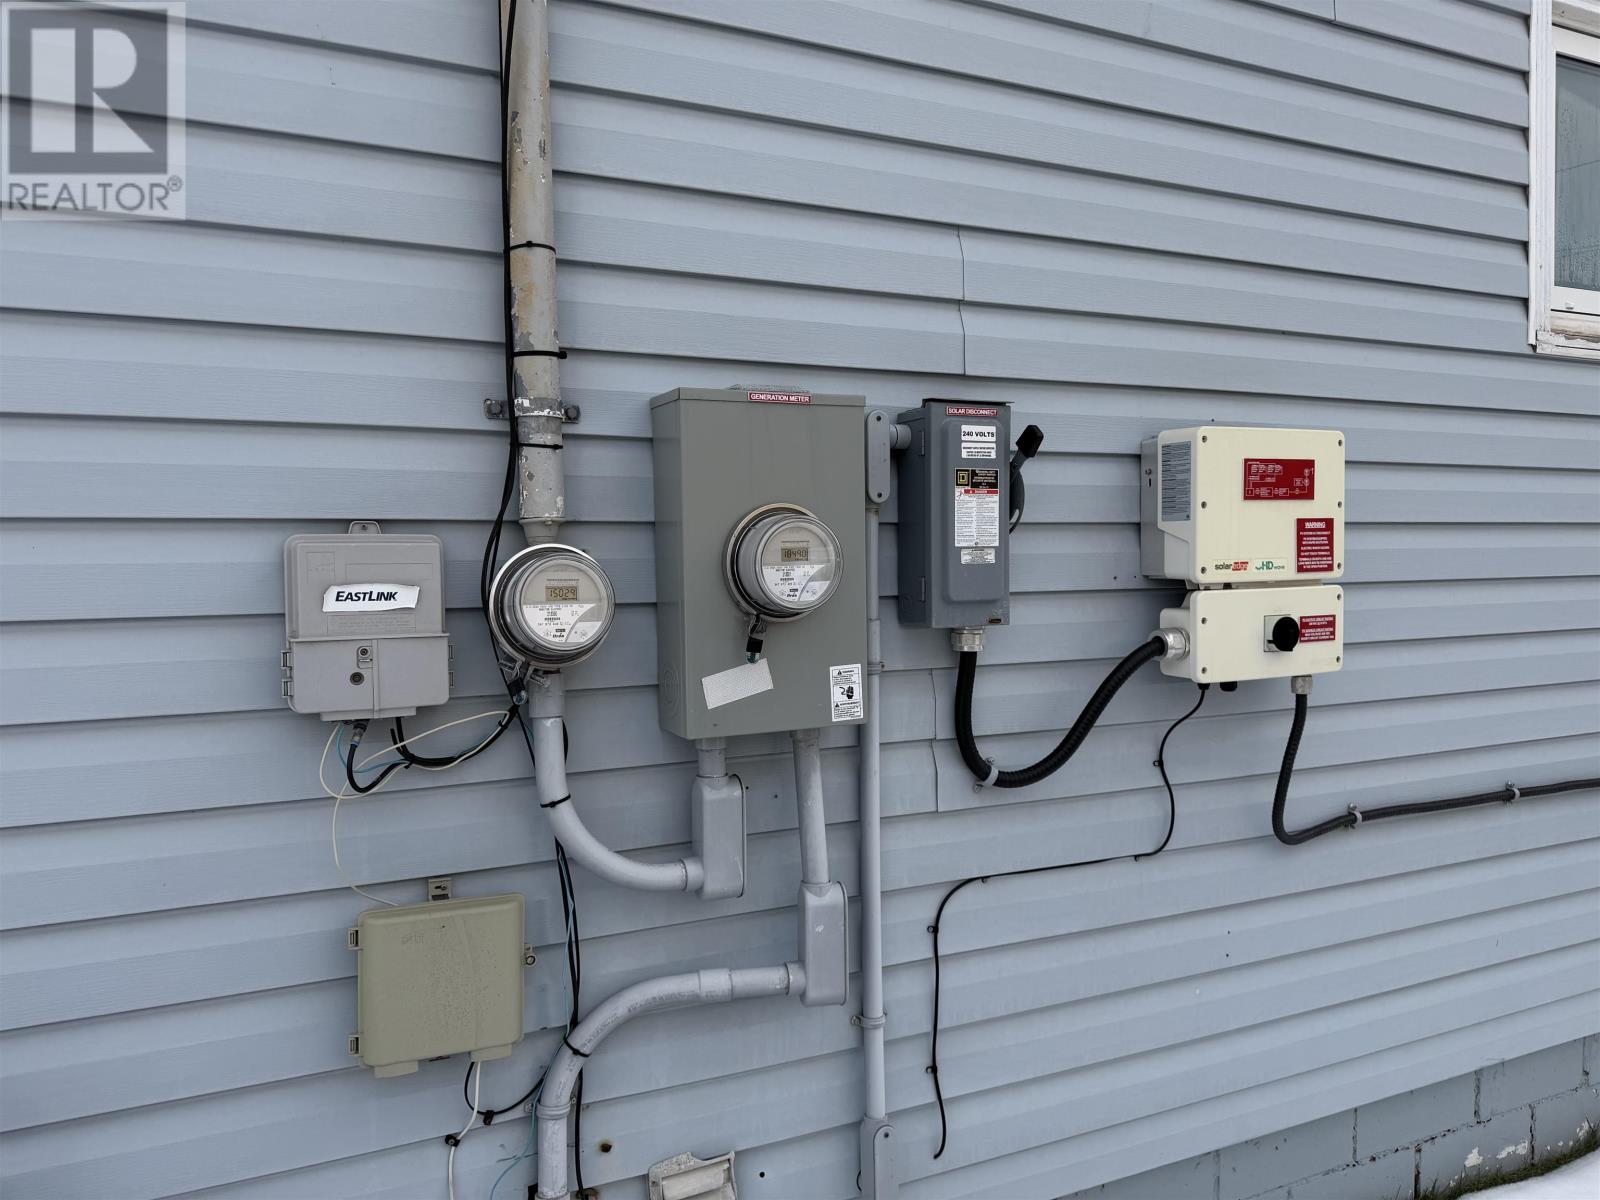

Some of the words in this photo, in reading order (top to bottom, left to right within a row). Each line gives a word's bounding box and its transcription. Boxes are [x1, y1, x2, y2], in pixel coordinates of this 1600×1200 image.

[750, 393, 788, 401] GENERATION
[789, 395, 810, 403] METER
[549, 588, 576, 598] 15029
